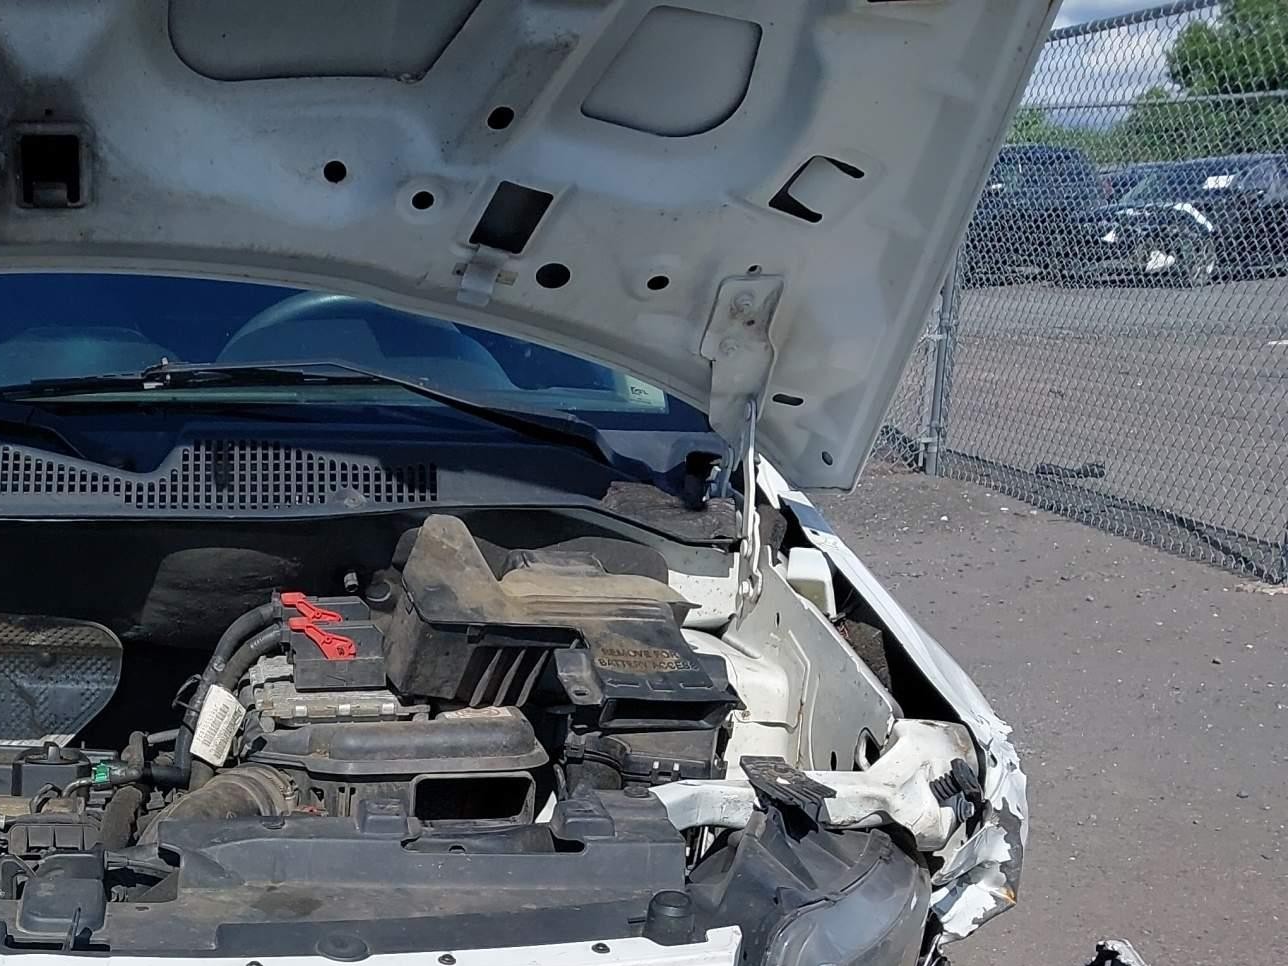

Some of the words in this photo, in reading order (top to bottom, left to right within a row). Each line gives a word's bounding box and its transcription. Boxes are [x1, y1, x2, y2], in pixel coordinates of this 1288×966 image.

[600, 648, 651, 659] REMOVE
[652, 649, 680, 660] FOR
[598, 658, 648, 669] BATTERY
[652, 660, 700, 670] ACCESS
